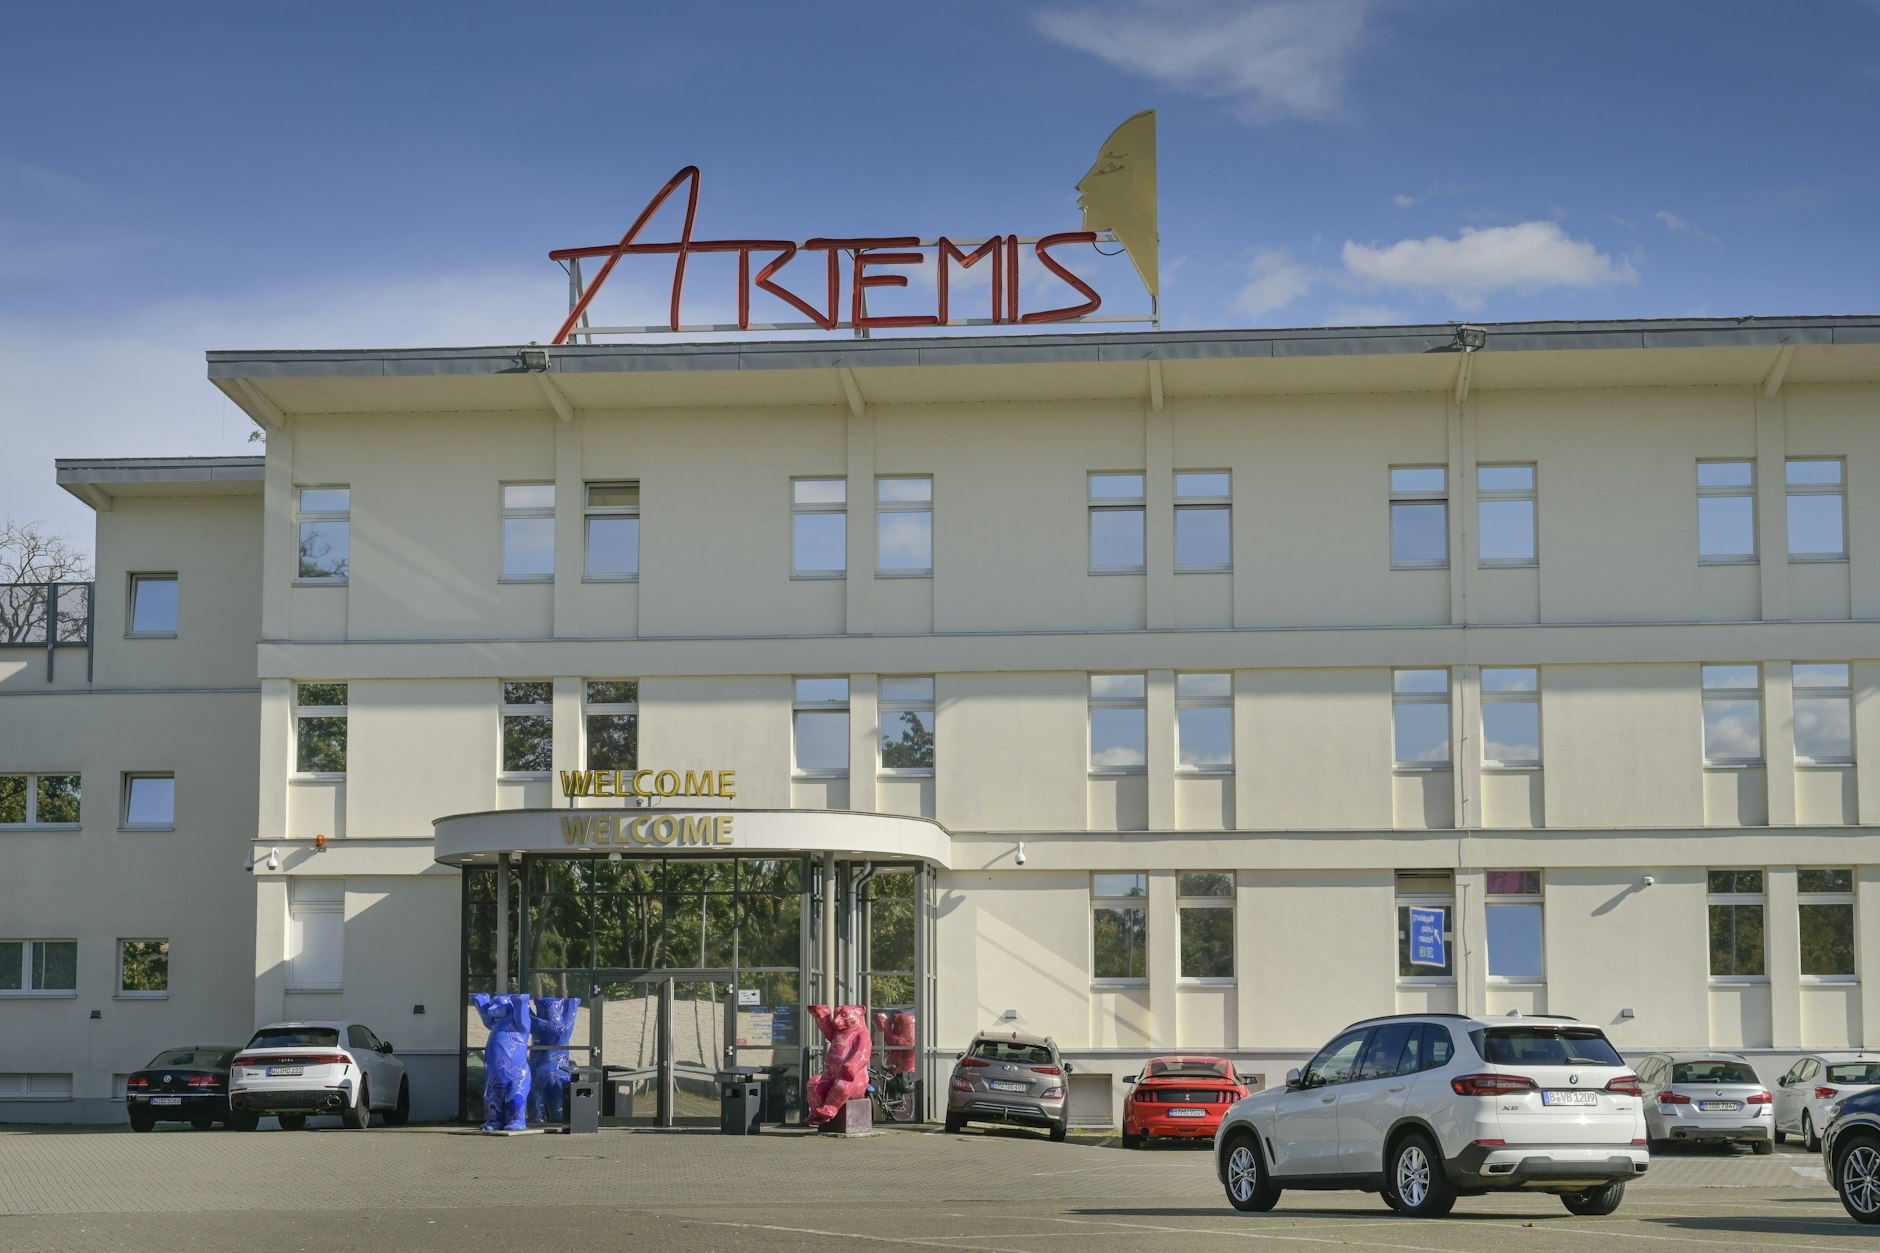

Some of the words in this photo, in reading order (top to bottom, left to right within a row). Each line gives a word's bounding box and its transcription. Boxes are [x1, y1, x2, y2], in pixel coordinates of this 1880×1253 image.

[549, 165, 1102, 344] ARTEMIS
[560, 769, 736, 798] WELCOME
[561, 815, 735, 845] WELCOME
[1549, 1092, 1556, 1102] B
[1561, 1092, 1573, 1102] VB
[1574, 1092, 1595, 1103] 1209
